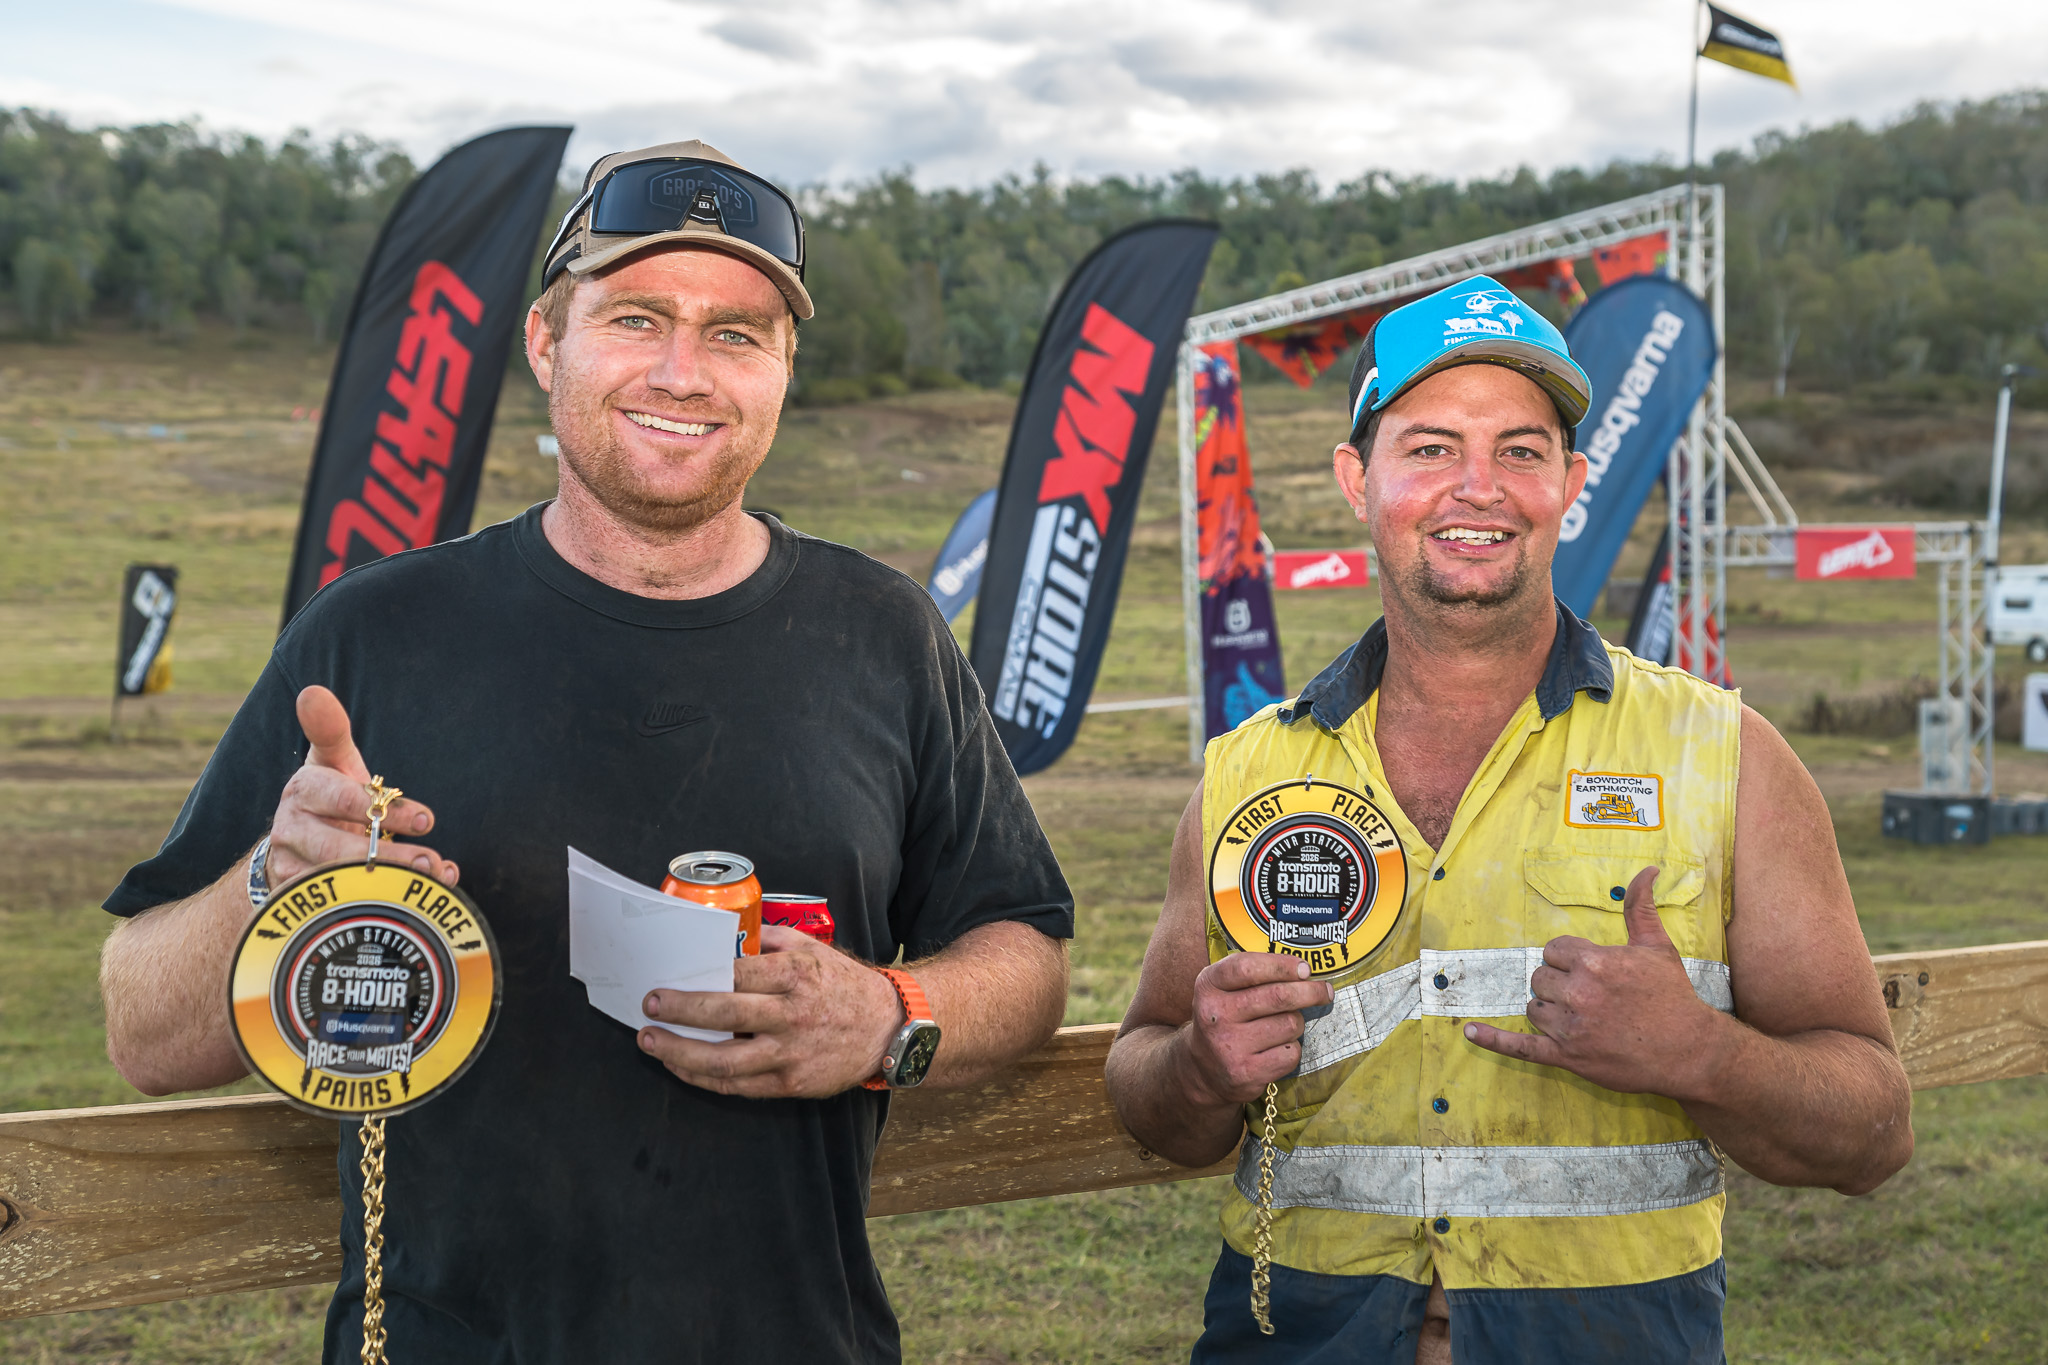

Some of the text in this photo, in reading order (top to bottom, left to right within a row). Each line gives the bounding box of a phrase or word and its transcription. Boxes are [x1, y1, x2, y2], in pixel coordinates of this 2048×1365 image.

[1015, 302, 1156, 740] MX STORE
[1575, 785, 1653, 795] EARTHMOVING
[1586, 776, 1642, 786] BOWDITCH
[1235, 794, 1386, 841] FIRST PLACE
[1271, 833, 1349, 860] MIVA STATION
[1300, 854, 1320, 862] 2026
[1278, 860, 1341, 873] transmoto
[1277, 873, 1341, 894] 8-HOUR
[272, 877, 472, 940] FIRST PLACE
[1291, 905, 1333, 915] Husqvarna
[1269, 918, 1348, 945] RACE YOUR MATES!
[318, 928, 421, 964] MIVA STATION
[325, 962, 410, 981] transmoto
[321, 979, 408, 1008] 8-HOUR
[337, 1018, 395, 1034] Husqvarna
[306, 1039, 347, 1070] RACE
[366, 1041, 414, 1074] MATES!
[312, 1076, 392, 1107] PAIRS
